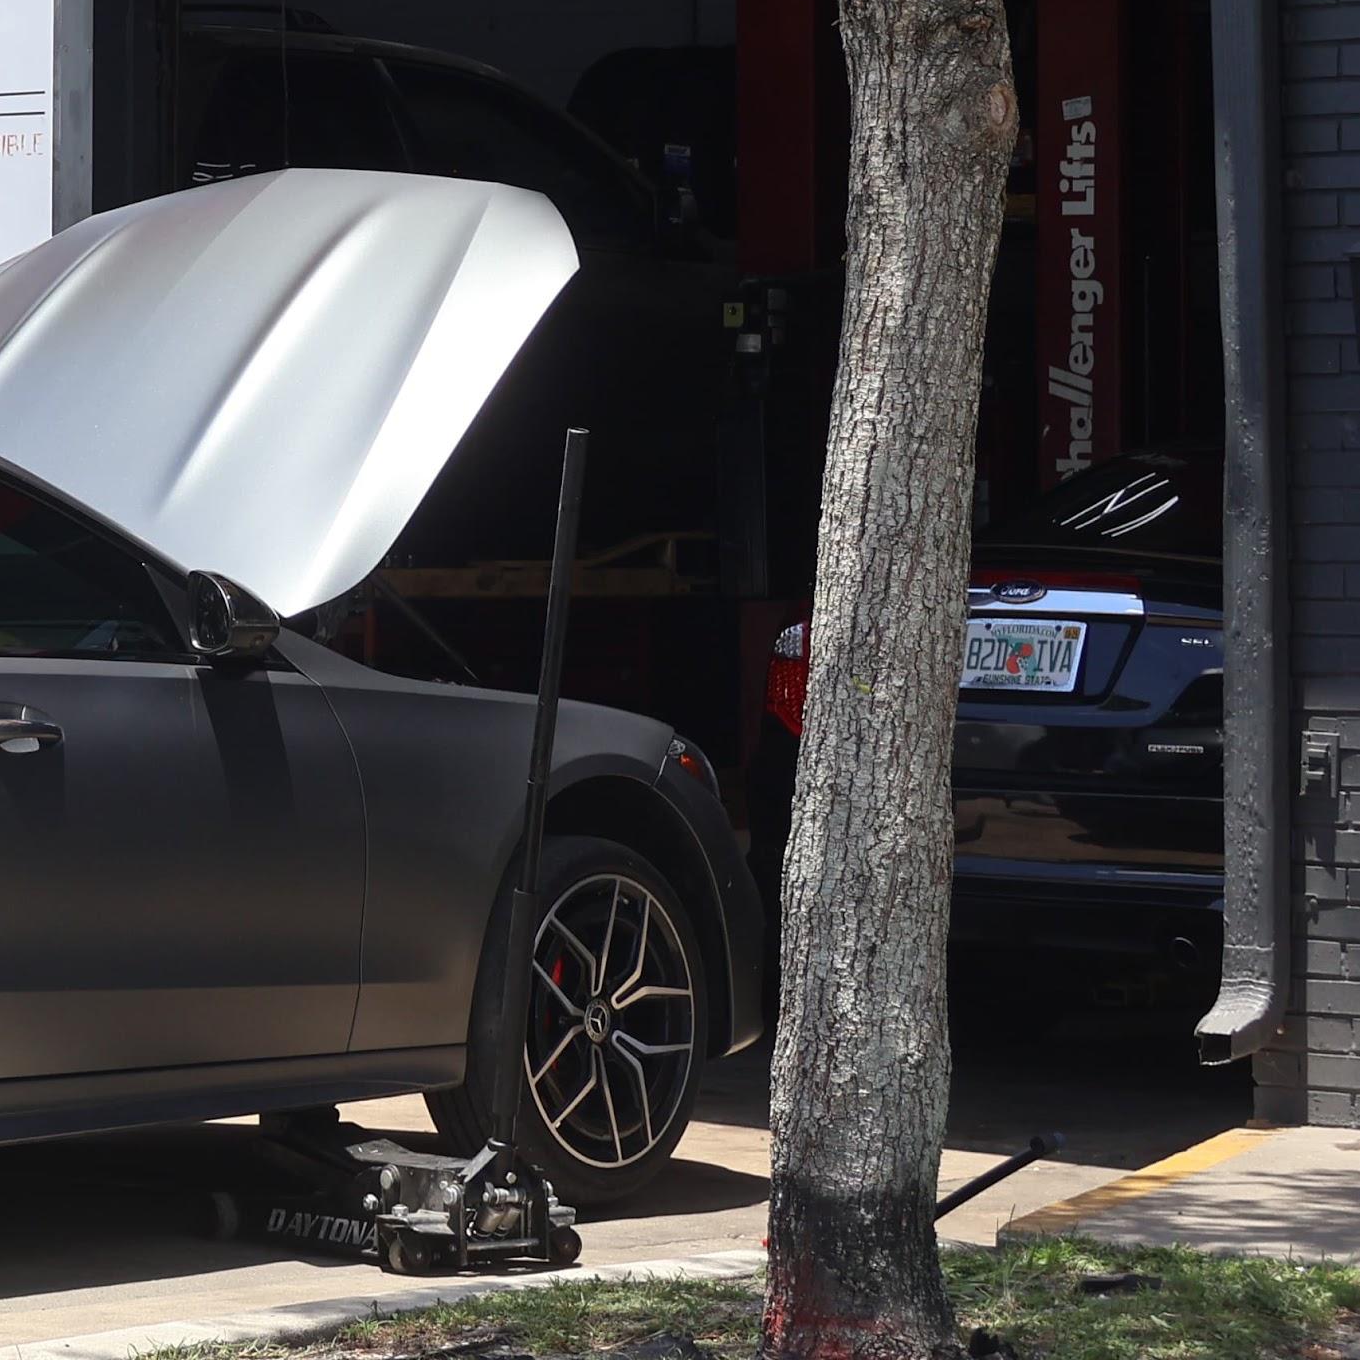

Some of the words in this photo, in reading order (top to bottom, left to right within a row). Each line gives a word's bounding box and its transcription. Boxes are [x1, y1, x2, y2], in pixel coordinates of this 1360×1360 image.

[1060, 120, 1096, 216] Lifts
[1049, 228, 1104, 478] hallenger
[1000, 585, 1031, 596] Ford
[267, 1208, 378, 1245] DAYTONA
